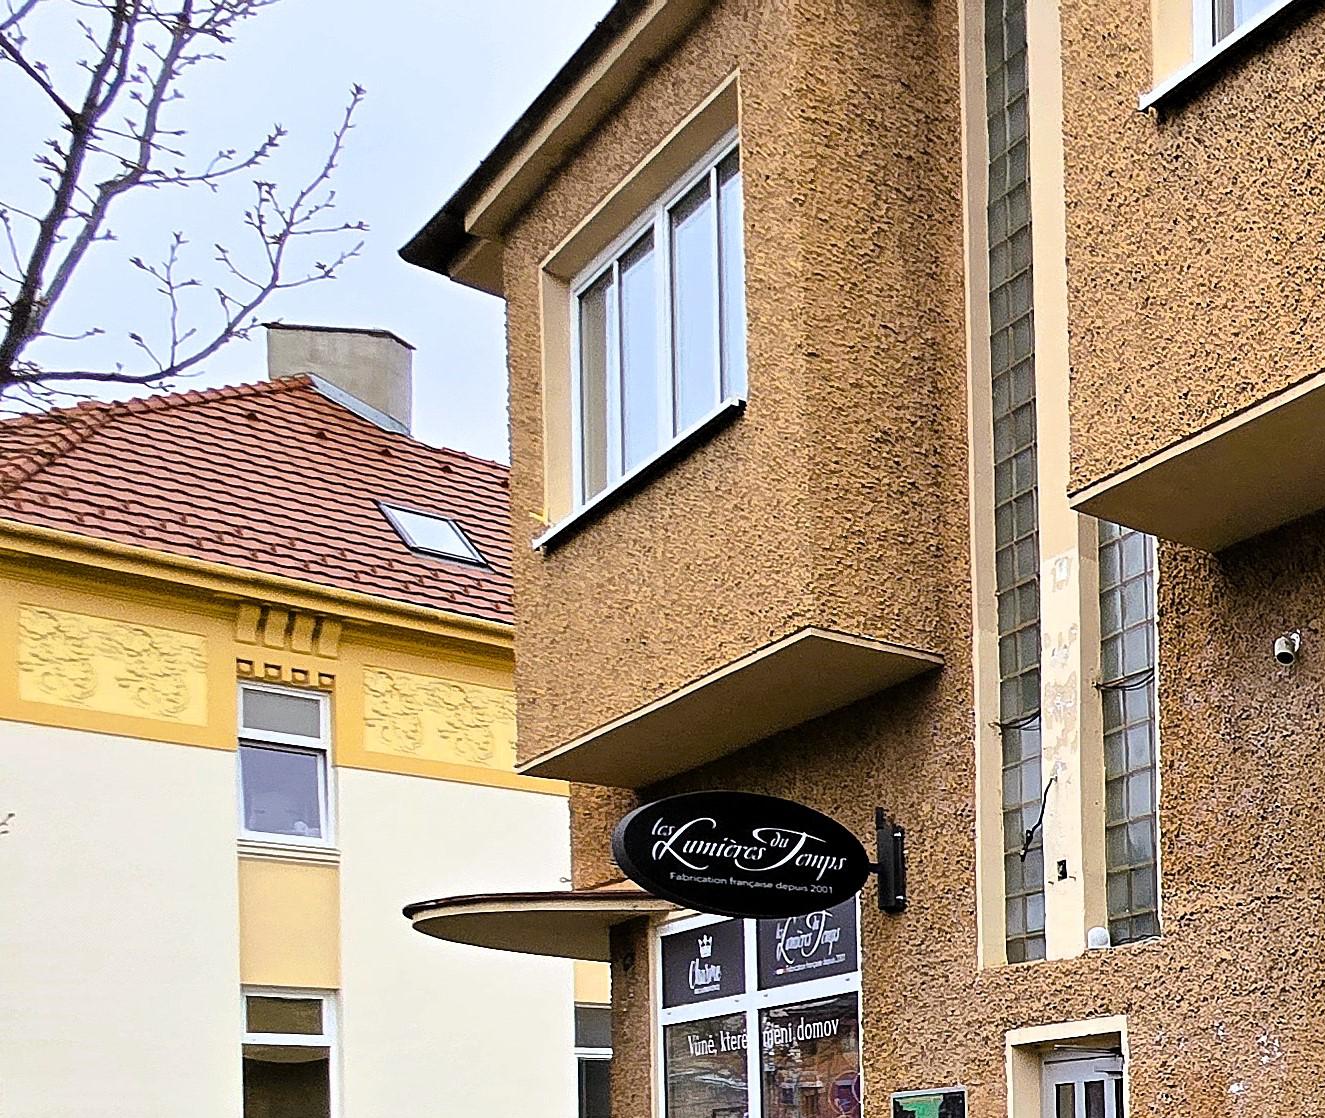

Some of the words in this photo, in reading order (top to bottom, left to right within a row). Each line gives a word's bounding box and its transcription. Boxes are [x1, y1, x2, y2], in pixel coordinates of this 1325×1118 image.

[651, 817, 676, 836] les
[651, 817, 767, 871] Lumières
[769, 832, 790, 849] du
[734, 827, 847, 881] Temps
[669, 872, 728, 886] Fabrication
[729, 877, 774, 889] française
[775, 882, 808, 893] depuis
[810, 884, 833, 894] 2001
[796, 1017, 840, 1041] domov
